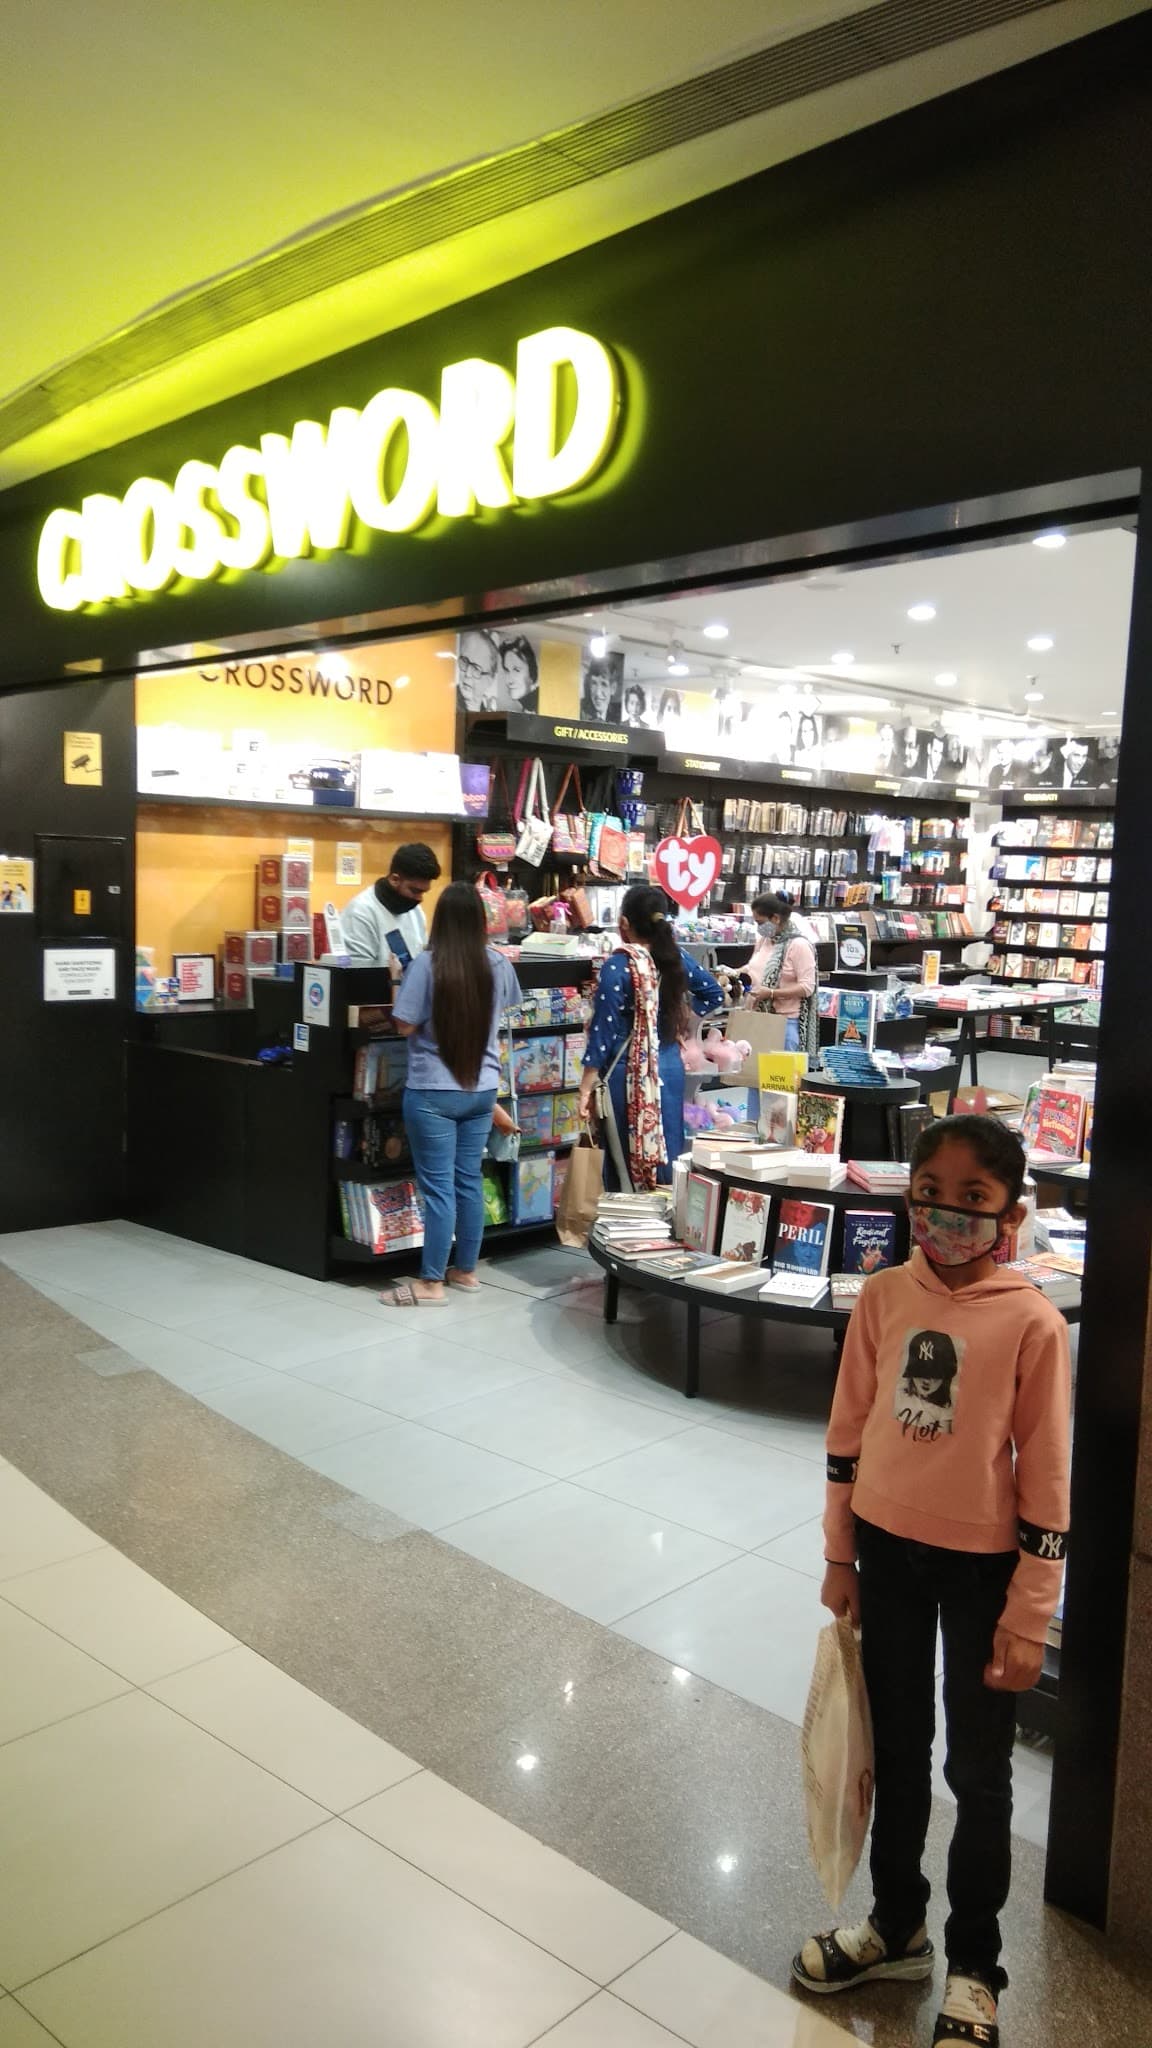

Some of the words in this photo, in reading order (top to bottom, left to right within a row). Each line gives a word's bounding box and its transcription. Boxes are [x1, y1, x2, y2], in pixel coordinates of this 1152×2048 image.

[37, 326, 620, 612] CROSSWORD
[659, 839, 716, 896] ty
[761, 1083, 795, 1093] ARRIVALS
[769, 1074, 786, 1082] NEW
[778, 1222, 823, 1246] PERIL
[919, 1341, 934, 1360] NY
[896, 1408, 943, 1441] Not
[1037, 1532, 1063, 1558] NY
